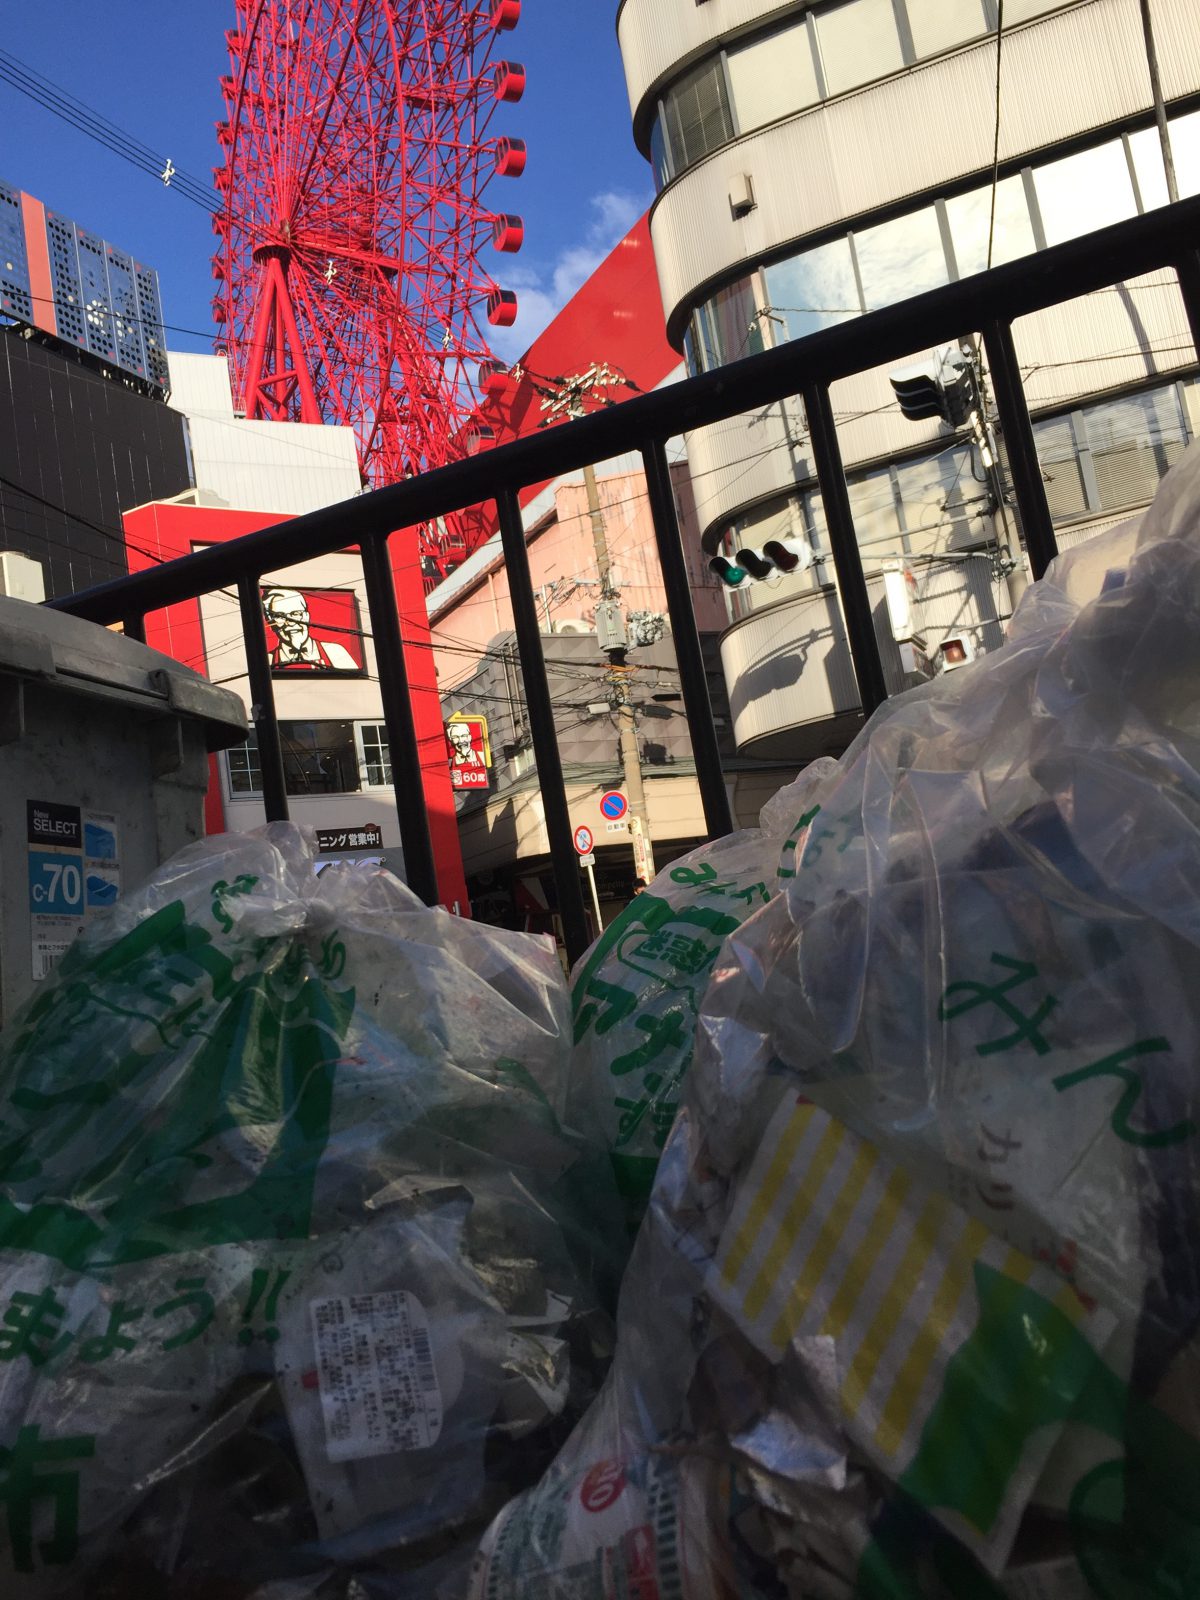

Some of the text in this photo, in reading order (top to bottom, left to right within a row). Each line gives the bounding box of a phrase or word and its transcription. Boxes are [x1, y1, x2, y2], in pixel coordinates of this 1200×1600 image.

[33, 819, 78, 836] SELECT
[316, 832, 380, 848] ニング営業中!
